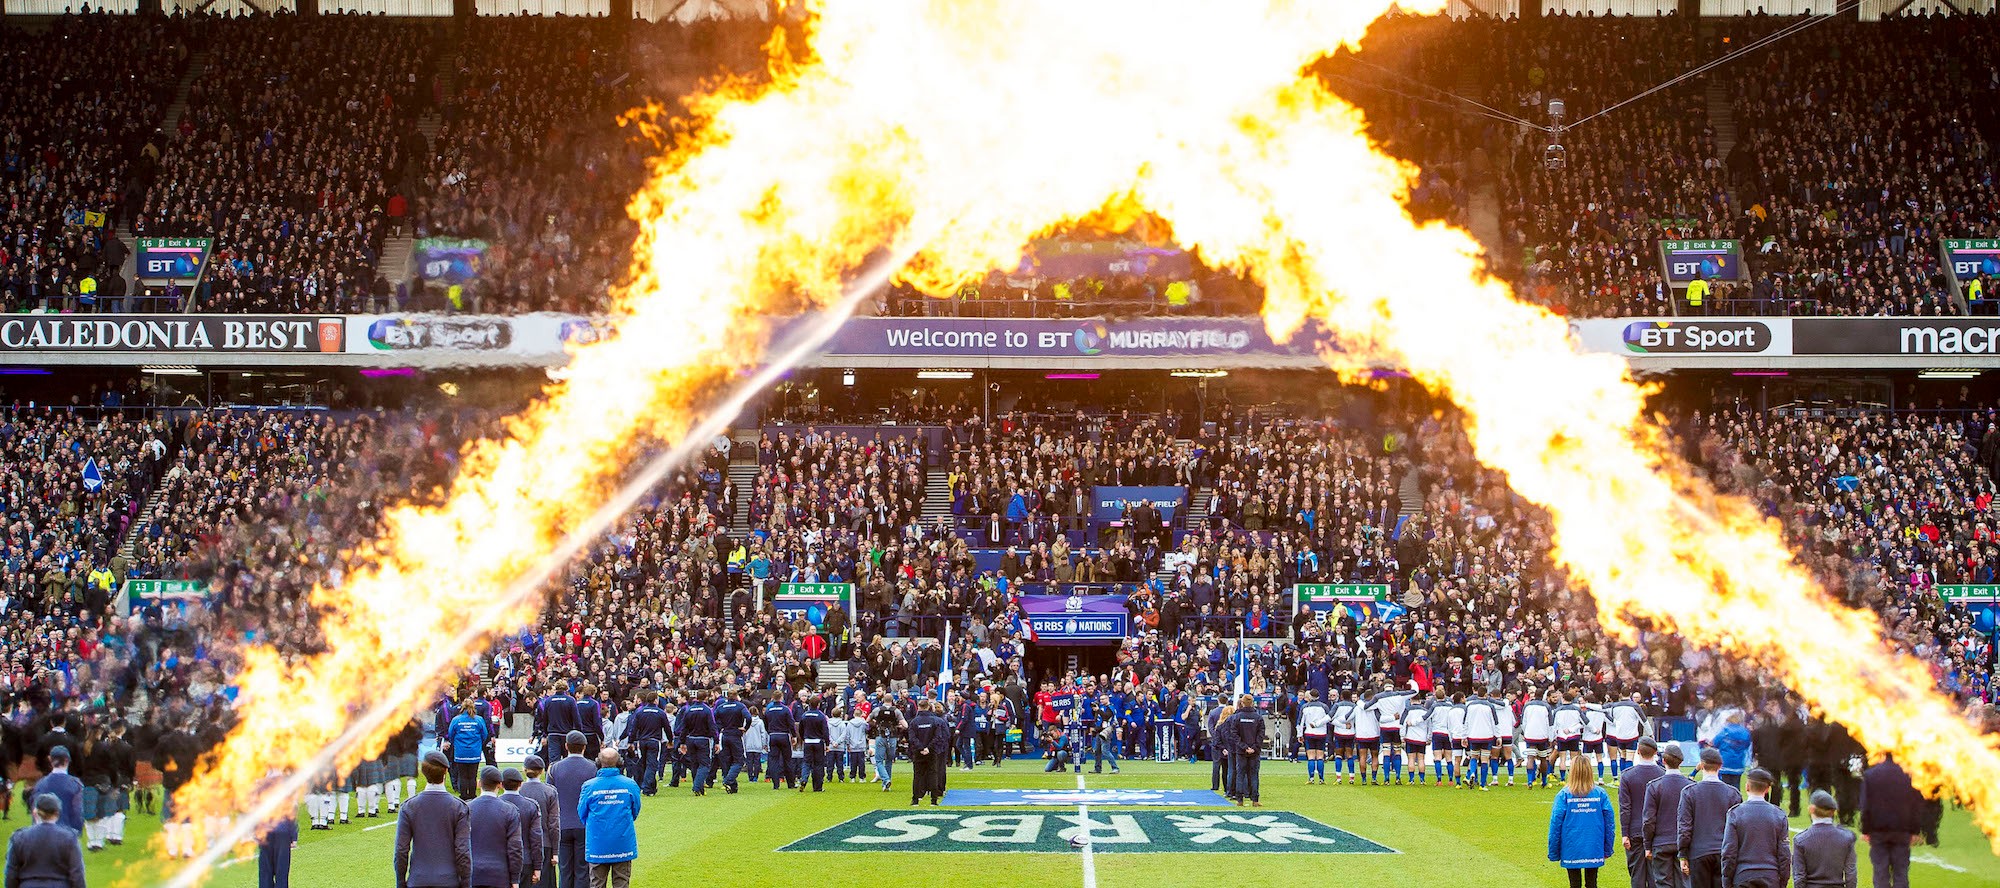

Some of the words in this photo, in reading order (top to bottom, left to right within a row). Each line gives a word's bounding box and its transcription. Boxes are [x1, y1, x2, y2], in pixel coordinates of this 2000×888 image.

[148, 260, 175, 272] BT
[1673, 262, 1700, 275] BT
[1955, 261, 1982, 274] BT
[1, 320, 213, 349] CALEDONIA
[222, 320, 312, 349] BEST
[886, 328, 997, 347] Welcome
[1004, 329, 1028, 348] to
[1038, 332, 1072, 348] BT
[1109, 329, 1250, 349] MURRAYFIELD
[1640, 328, 1681, 347] BT
[1685, 326, 1755, 350] Sport
[1101, 500, 1114, 508] BT
[135, 583, 146, 591] 13
[832, 586, 843, 594] 17
[1304, 587, 1316, 595] 19
[1368, 587, 1379, 595] 19
[1943, 588, 1954, 596] 23
[1973, 587, 1988, 595] Exit
[1044, 621, 1063, 631] RBS
[1079, 621, 1112, 631] NATIONS
[1059, 698, 1071, 707] RBS
[841, 814, 1152, 844] RBS
